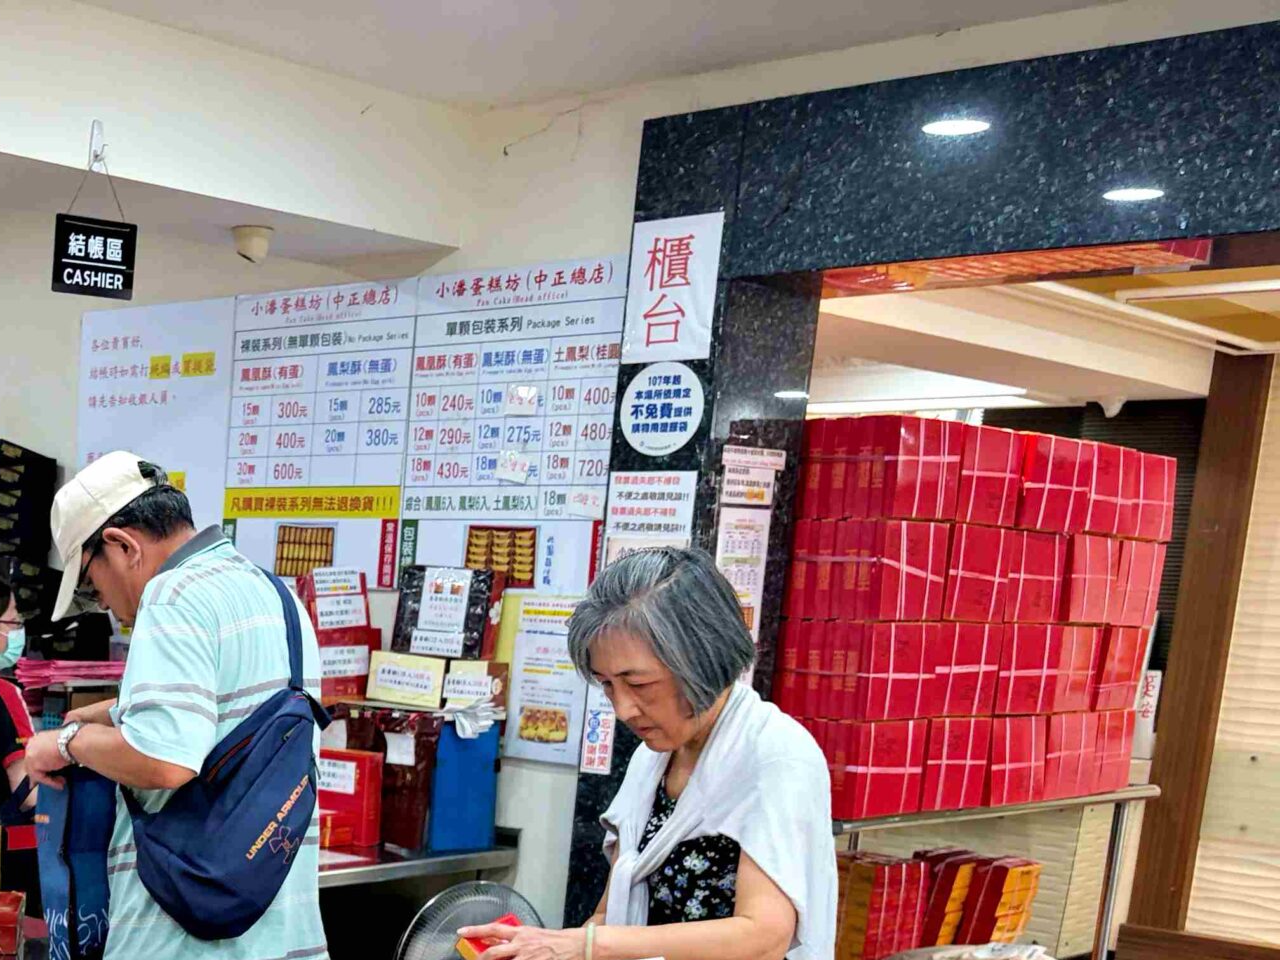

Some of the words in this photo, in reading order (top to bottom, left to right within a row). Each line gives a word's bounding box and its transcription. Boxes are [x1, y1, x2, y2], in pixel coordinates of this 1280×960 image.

[68, 232, 123, 262] 結帳區
[63, 268, 124, 290] CASHIER
[643, 234, 695, 347] 櫃台
[445, 316, 523, 337] 單顆包裝系列
[527, 319, 561, 330] Package
[565, 316, 596, 326] Series
[240, 331, 348, 353] 裸裝系列(無單顆包裝)
[358, 333, 385, 344] Package
[386, 331, 409, 340] Series
[482, 348, 550, 367] 鳳梨酥(無蛋)
[648, 375, 681, 387] 107年起
[277, 402, 308, 419] 300元
[368, 397, 402, 415] 285元
[441, 395, 474, 412] 240元
[480, 388, 503, 405] 10顆
[552, 385, 576, 401] 10顆
[276, 432, 306, 449] 400元
[325, 429, 345, 444] 20顆
[366, 429, 398, 446] 380元
[413, 427, 435, 442] 12顆
[439, 428, 472, 445] 290元
[478, 424, 500, 440] 12顆
[506, 425, 541, 443] 275元
[549, 422, 573, 437] 12顆
[273, 463, 303, 480] 600元
[411, 458, 432, 472] 18顆
[437, 462, 469, 479] 430元
[475, 455, 497, 471] 18顆
[546, 454, 570, 470] 18顆
[543, 489, 567, 506] 18顆
[246, 821, 278, 860] UNDER
